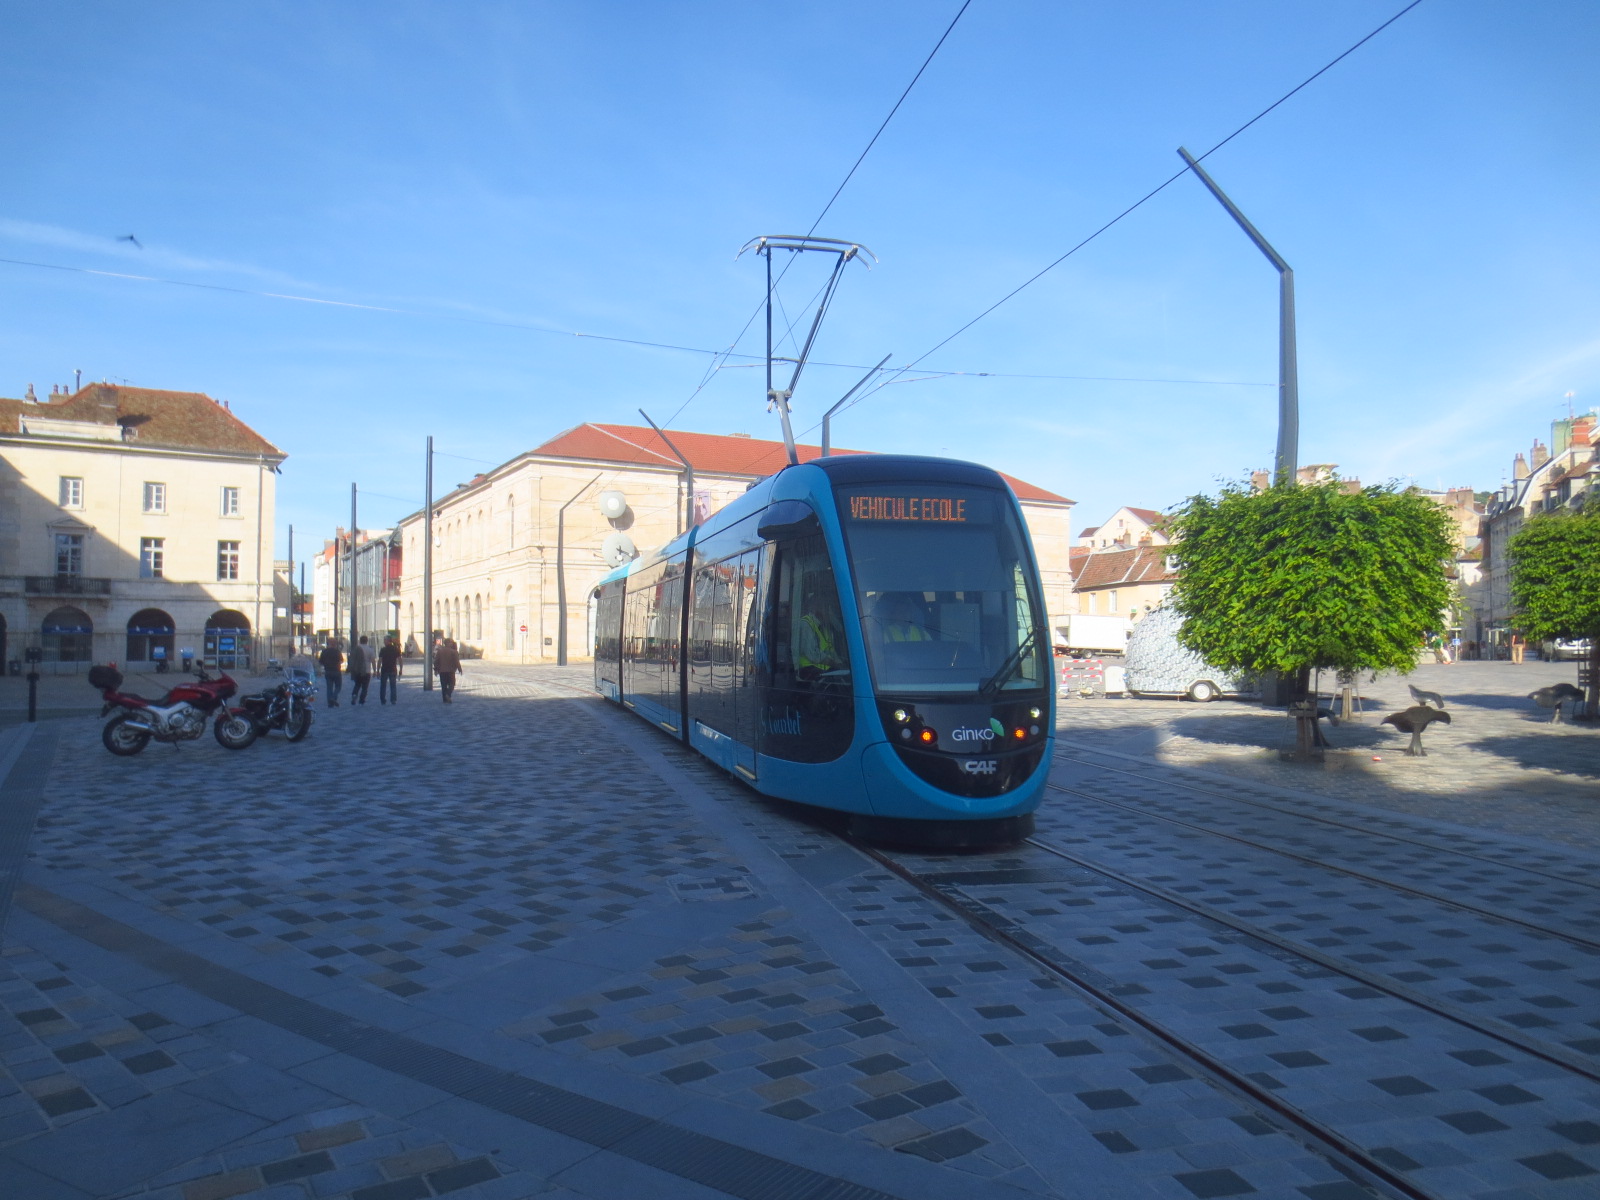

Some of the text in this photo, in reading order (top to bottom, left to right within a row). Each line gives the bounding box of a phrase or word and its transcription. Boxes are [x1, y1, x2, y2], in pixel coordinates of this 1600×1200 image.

[850, 496, 966, 522] VEHICULE ECOLE
[965, 760, 997, 774] CAF
